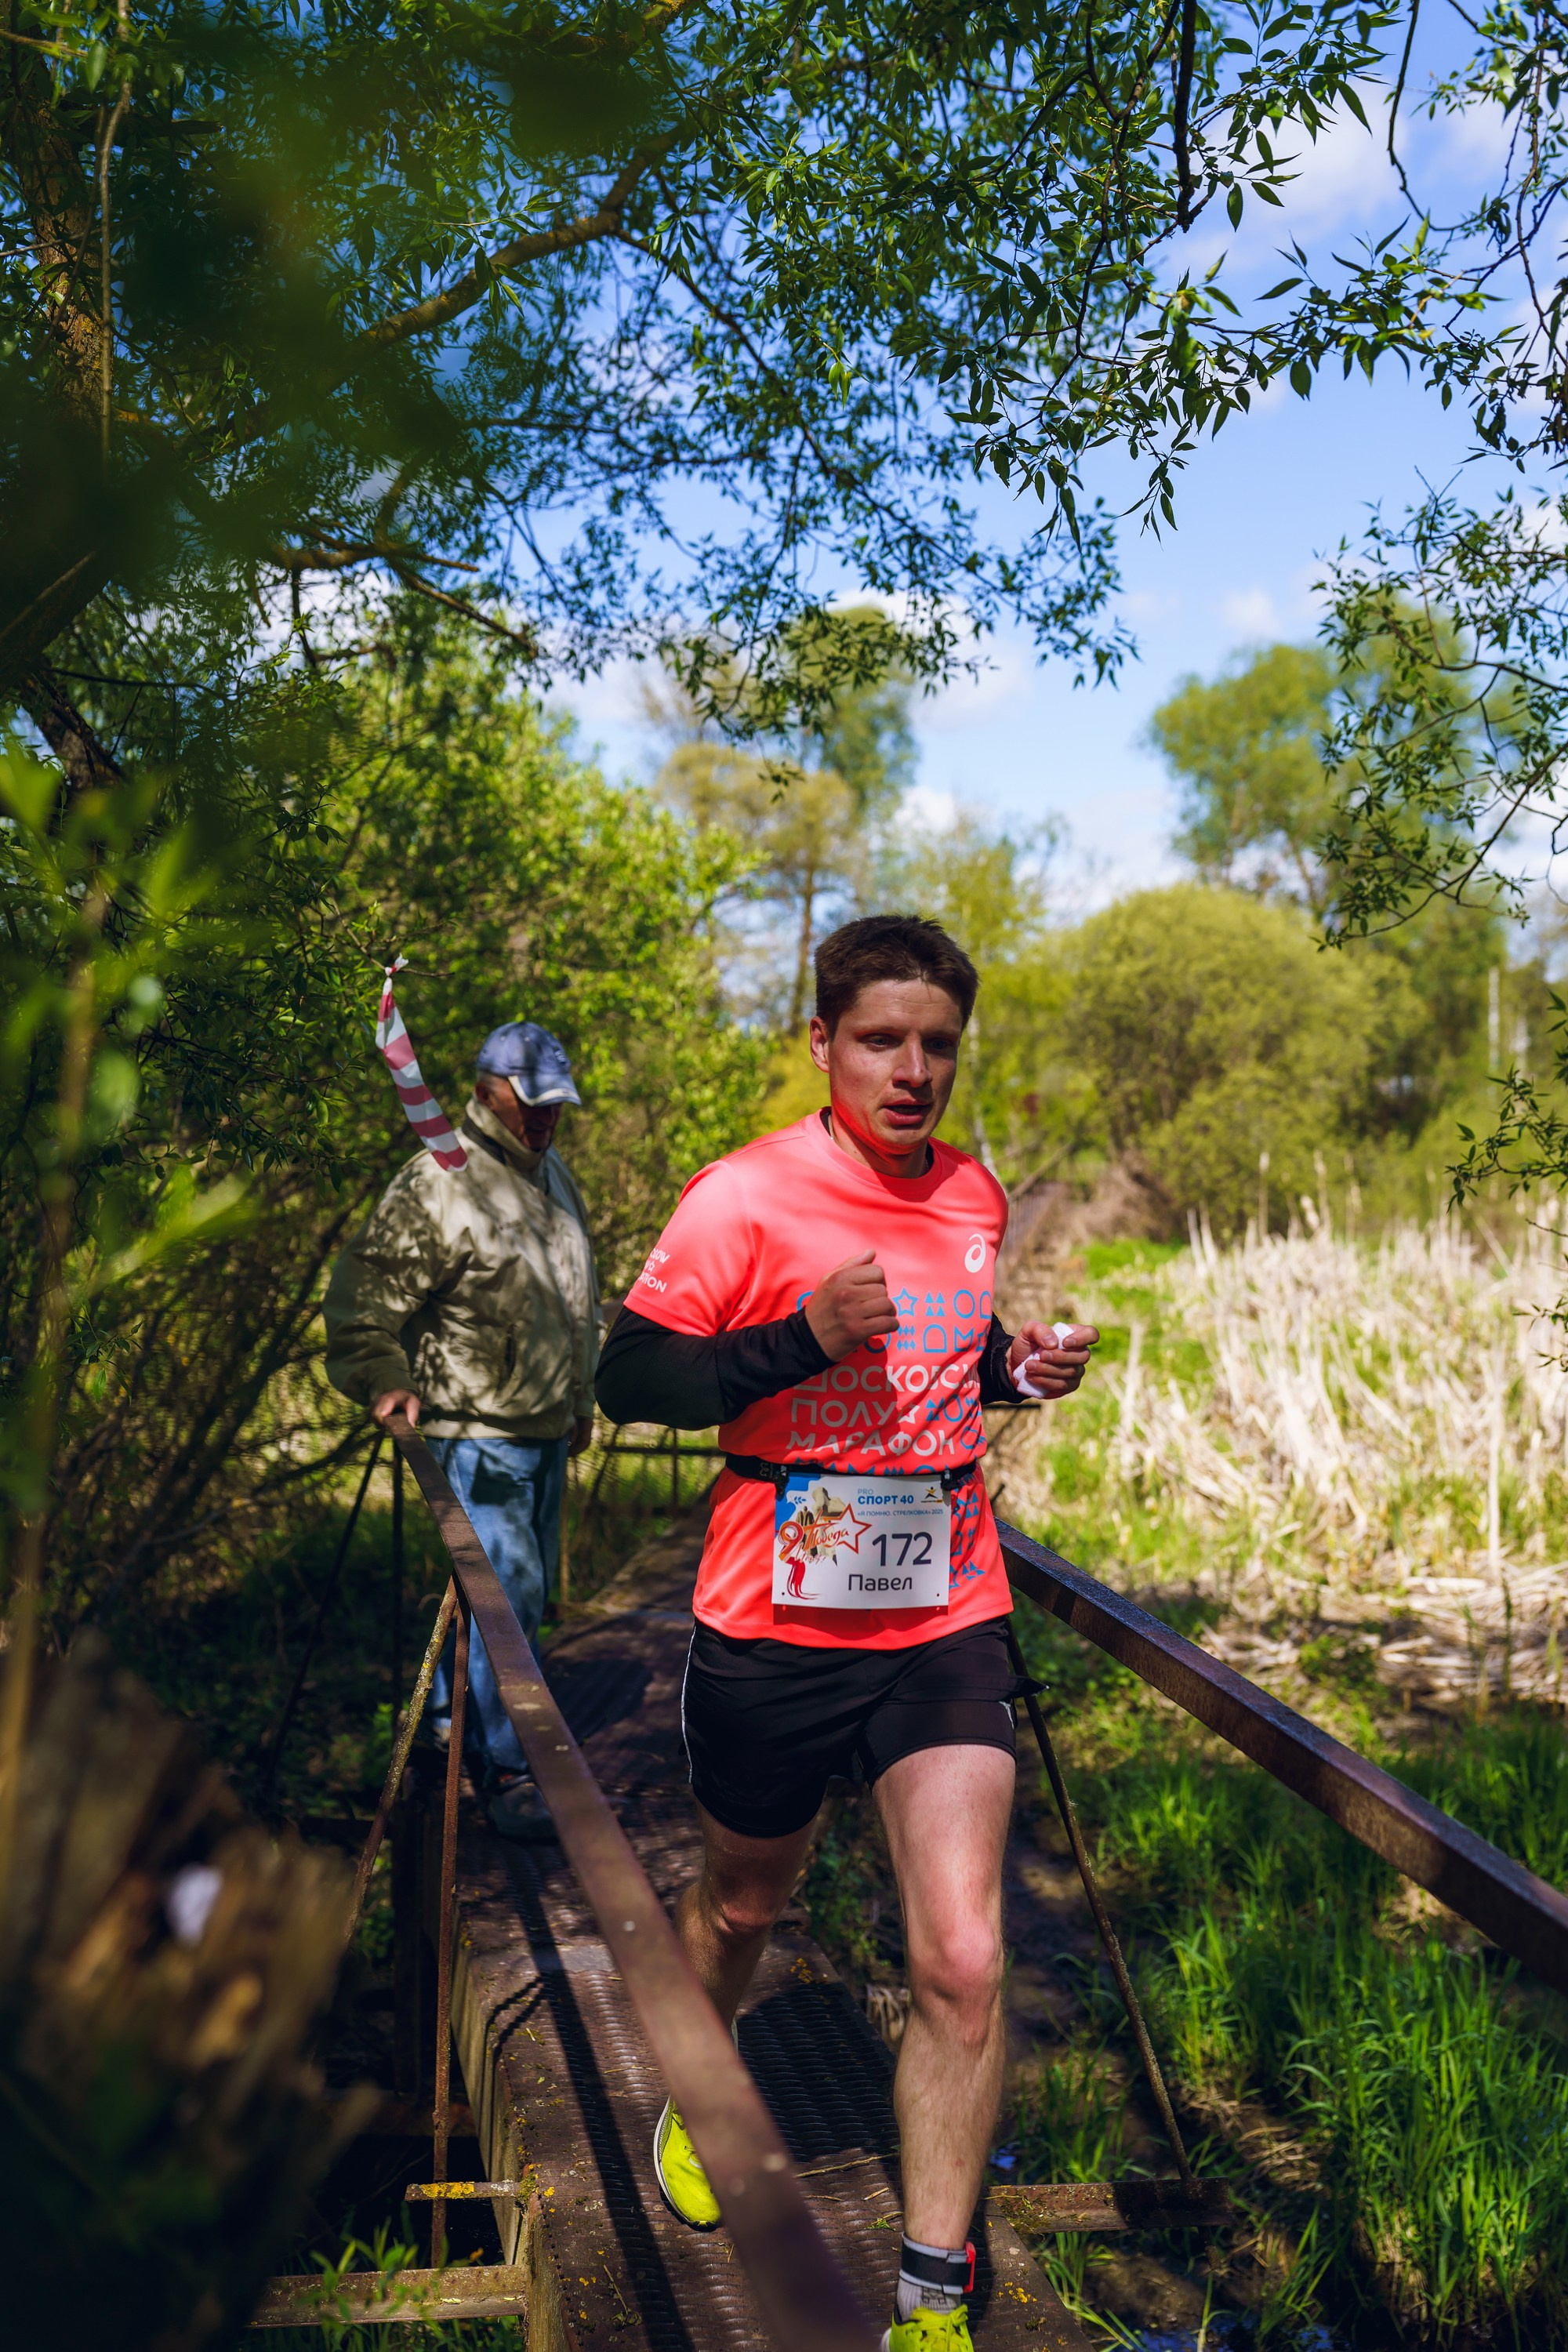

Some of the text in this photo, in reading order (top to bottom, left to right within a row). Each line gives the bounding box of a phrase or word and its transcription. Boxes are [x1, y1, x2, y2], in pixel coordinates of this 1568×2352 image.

[791, 1398, 898, 1428] ПОЛУ
[786, 1430, 955, 1457] МАРАФОН
[858, 1495, 898, 1504] СПОРТ
[900, 1495, 914, 1504] 40
[872, 1532, 932, 1566] 172
[848, 1574, 913, 1592] Павел
